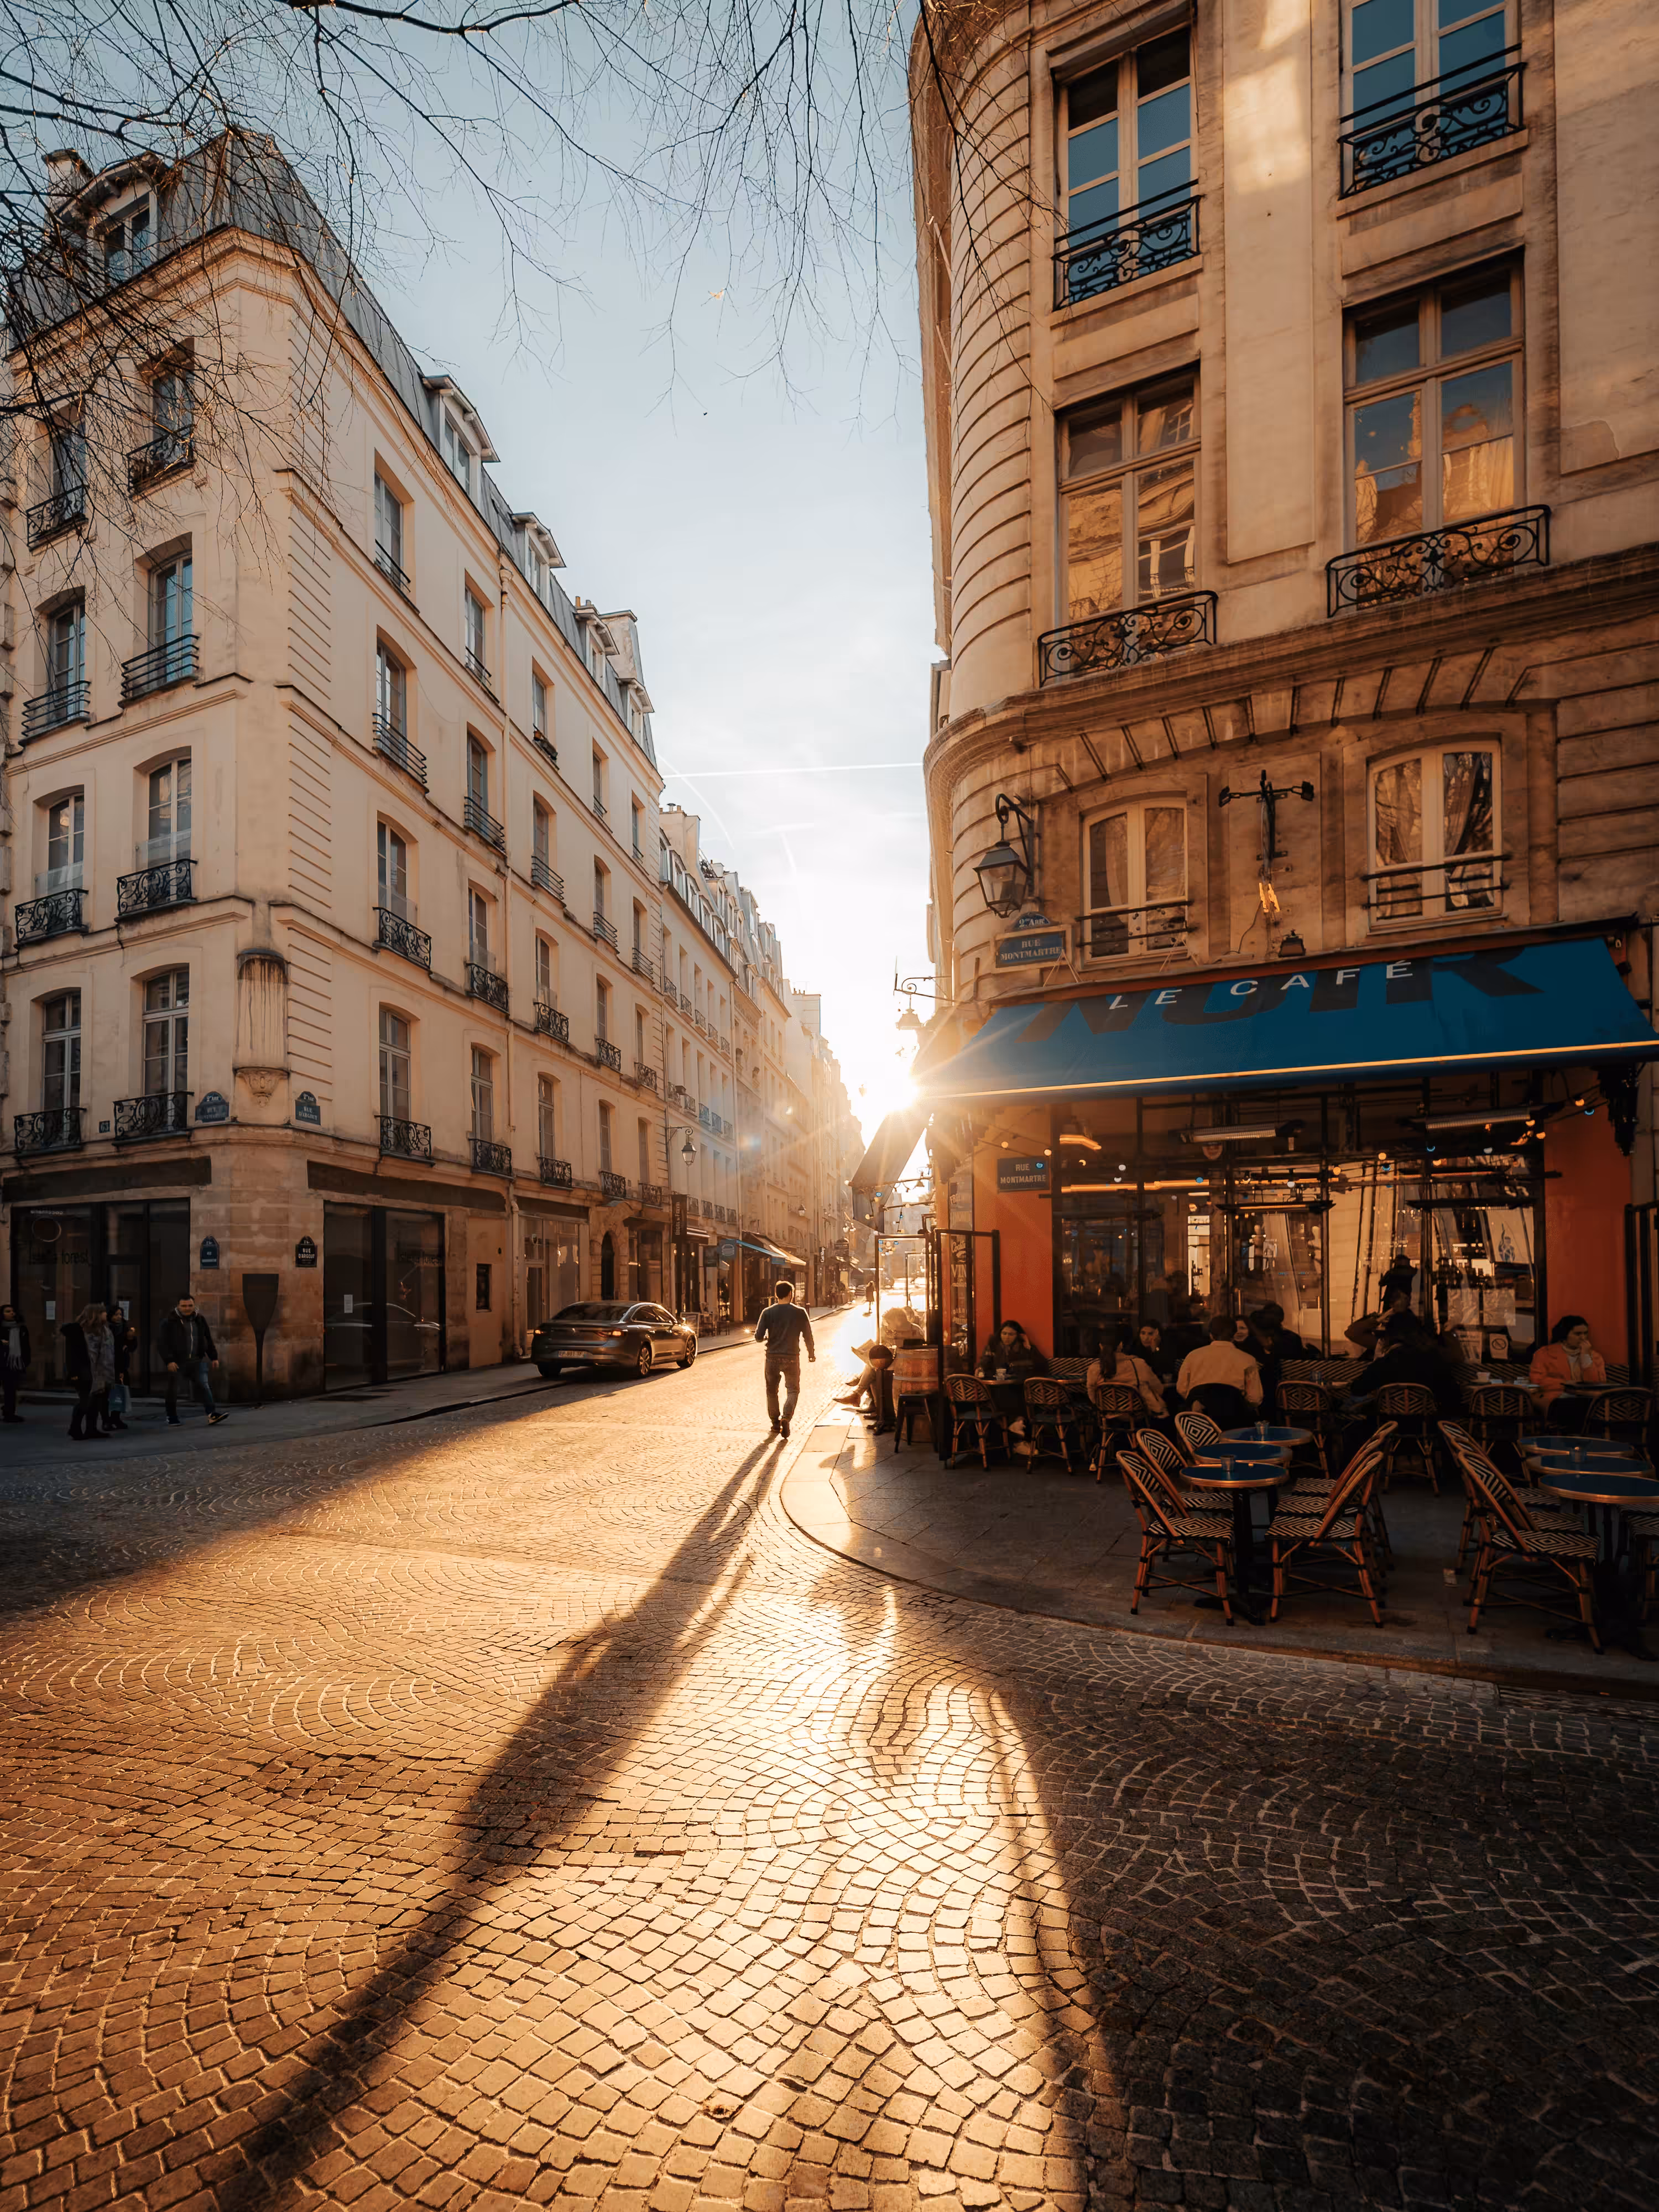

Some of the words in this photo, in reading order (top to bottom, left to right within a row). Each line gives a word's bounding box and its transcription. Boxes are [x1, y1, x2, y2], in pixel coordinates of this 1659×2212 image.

[1022, 939, 1041, 948] RUE
[1000, 946, 1062, 961] MONTMARTRE
[1108, 988, 1182, 1010] LE
[1230, 960, 1413, 995] CAFÉ
[1000, 1175, 1046, 1184] MONTMARTRE
